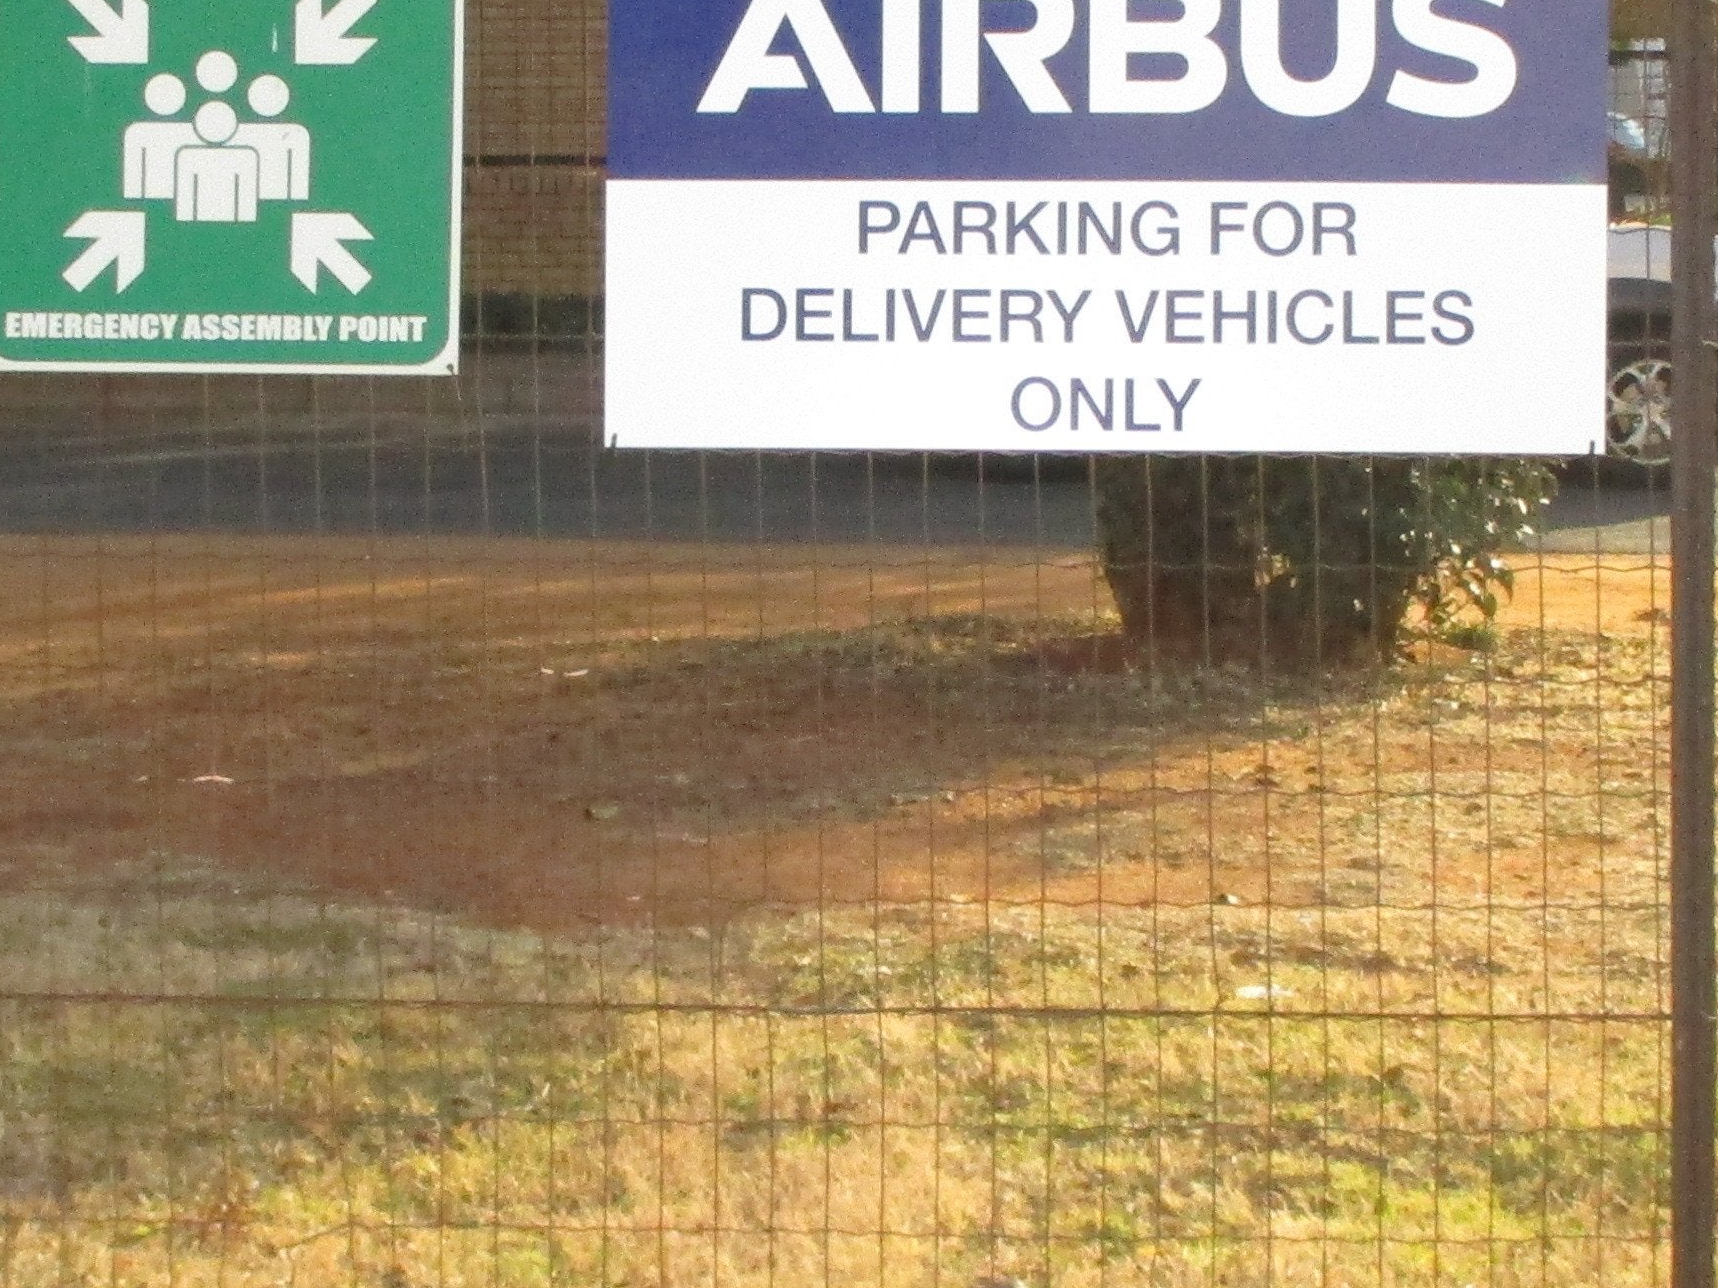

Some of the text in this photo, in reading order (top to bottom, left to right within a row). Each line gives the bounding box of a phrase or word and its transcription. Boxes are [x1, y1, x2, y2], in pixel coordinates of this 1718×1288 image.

[857, 200, 1357, 257] PARKING FOR
[4, 311, 428, 343] EMERGENCY ASSEMBLY POINT
[740, 287, 1476, 346] DELIVERY VEHICLES
[1010, 376, 1202, 433] ONLY
